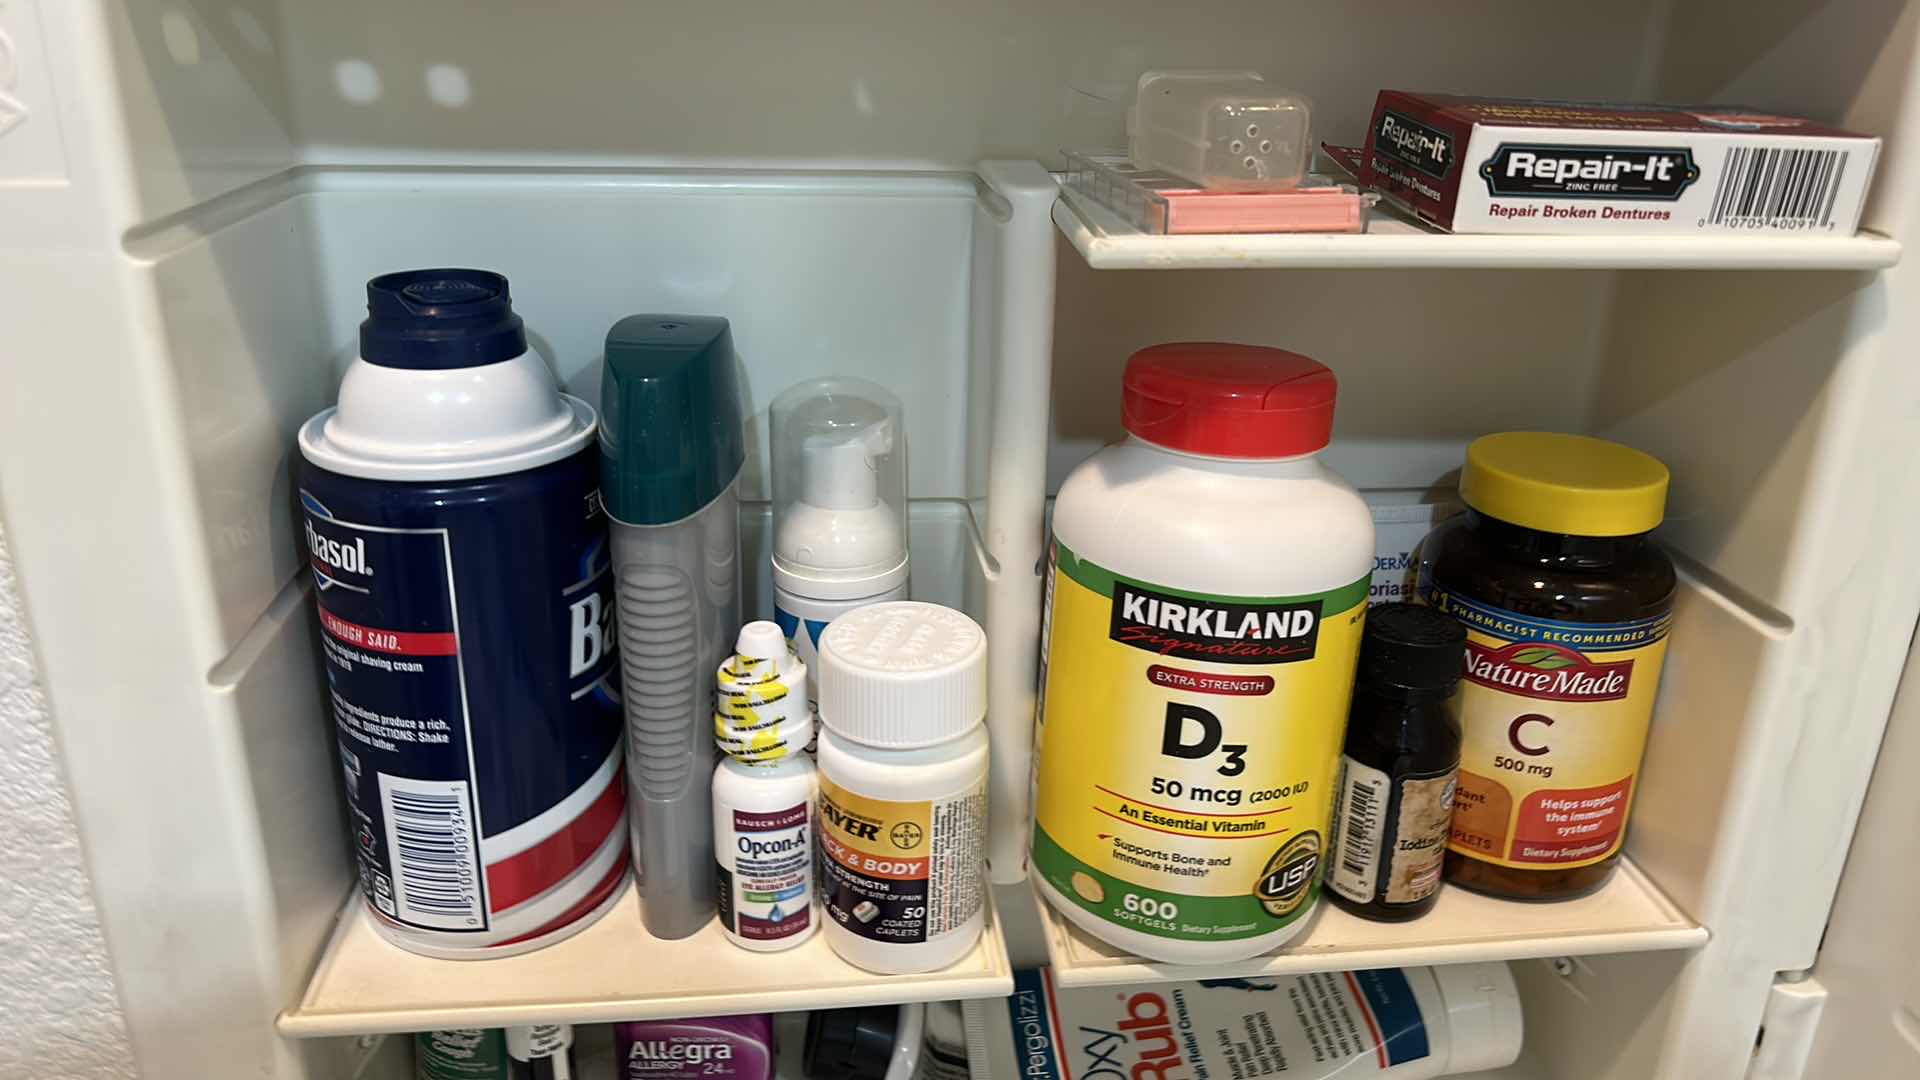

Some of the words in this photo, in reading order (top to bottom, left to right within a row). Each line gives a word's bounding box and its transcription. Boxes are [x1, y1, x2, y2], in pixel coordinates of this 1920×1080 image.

[1381, 116, 1446, 163] Repair-It
[1506, 152, 1675, 184] Repair-It
[1565, 182, 1591, 192] ZINC
[1593, 183, 1618, 192] FREE
[1489, 203, 1539, 220] Repair
[1543, 205, 1597, 219] Broken
[1601, 206, 1671, 220] Dentures
[1122, 591, 1315, 640] KIRKLAND
[1452, 603, 1537, 638] PHARMACIST
[1542, 630, 1646, 644] RECOMMENDED
[1119, 625, 1315, 656] Signature
[360, 654, 393, 672] shaving
[393, 661, 424, 673] cream
[1155, 670, 1197, 687] EXTRA
[1199, 673, 1266, 692] STRENGTH
[362, 720, 418, 743] DIRECTIONS:
[418, 730, 450, 744] Shake
[380, 715, 417, 730] produce
[418, 721, 426, 730] a
[1508, 713, 1555, 757] C
[1494, 756, 1525, 772] 500
[1527, 764, 1553, 778] mg
[1151, 777, 1183, 798] 50
[1190, 785, 1243, 806] mcg
[1249, 788, 1289, 804] (2000
[1292, 781, 1310, 797] IU)
[1540, 799, 1579, 811] Helps
[1546, 811, 1569, 823] the
[1570, 807, 1616, 822] immune
[821, 803, 882, 842] AYER
[1119, 803, 1139, 819] An
[1142, 811, 1208, 832] Essential
[1211, 819, 1266, 833] Vitamin
[737, 829, 806, 860] Opcon-A
[1113, 837, 1169, 861] Supports
[1171, 850, 1205, 866] Bone
[1207, 855, 1231, 867] and
[1522, 845, 1559, 859] Dietary
[1560, 840, 1609, 857] Supplement
[847, 853, 860, 867] &
[863, 859, 923, 875] BODY
[1112, 850, 1161, 872] Immune
[1267, 855, 1318, 894] USP
[902, 907, 926, 919] 50
[1123, 893, 1178, 920] 600
[875, 927, 921, 936] CAPLETS
[881, 919, 923, 928] COATED
[1113, 908, 1177, 932] SOFTGELS
[1172, 988, 1192, 1030] Cream
[629, 1040, 732, 1064] Allegra
[629, 1060, 685, 1070] ALLERGY
[703, 1063, 724, 1075] 24
